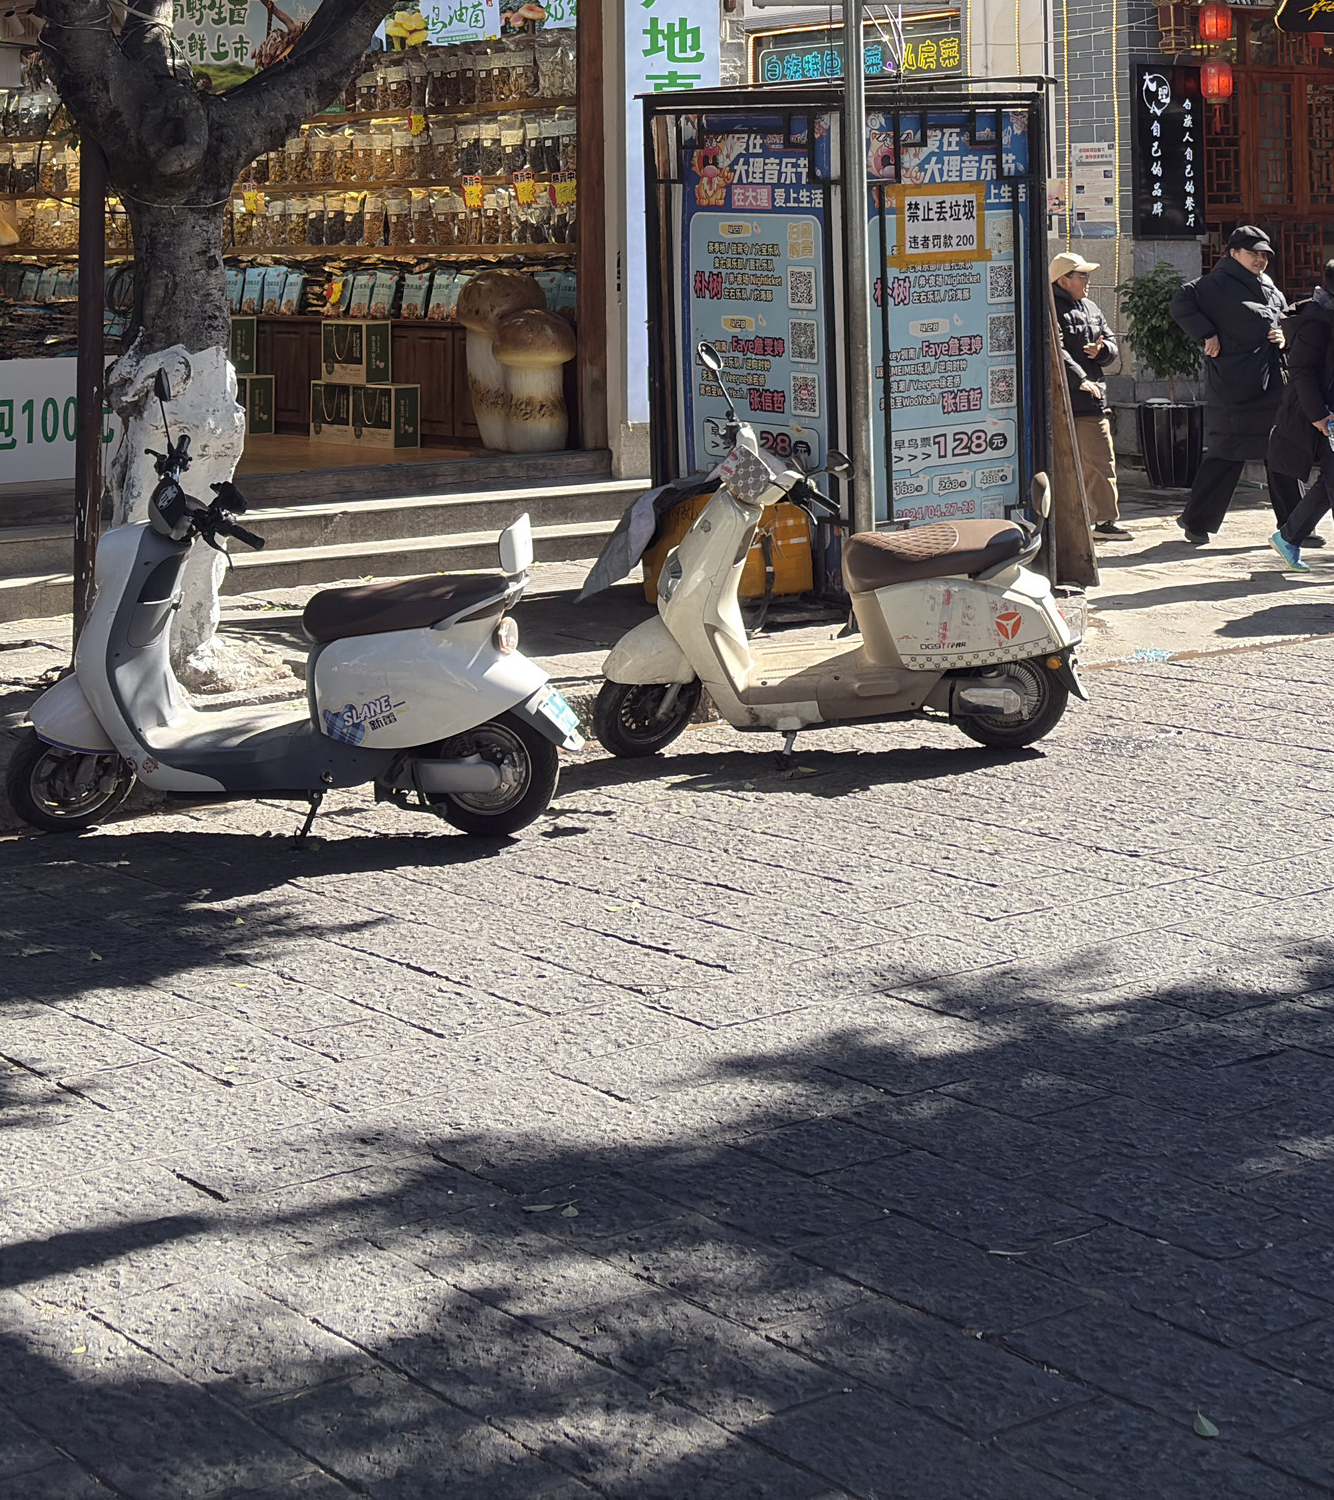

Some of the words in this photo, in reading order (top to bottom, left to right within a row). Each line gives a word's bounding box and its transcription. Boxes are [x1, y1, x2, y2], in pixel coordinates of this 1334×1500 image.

[424, 0, 486, 34] 鸡油菌
[764, 45, 882, 82] 白族特色菜
[732, 157, 808, 185] 大理音乐节
[923, 152, 1016, 184] 大理音乐节
[733, 187, 769, 207] 在大理
[774, 188, 824, 208] 爱上生活
[906, 200, 975, 223] 禁止丢垃圾
[908, 234, 953, 250] 违者罚款
[956, 234, 975, 247] 200
[694, 270, 723, 299] 朴树
[748, 388, 785, 414] 张信哲
[941, 387, 983, 414] 张信哲
[893, 436, 932, 451] 早鸟票
[343, 694, 393, 727] SLANE
